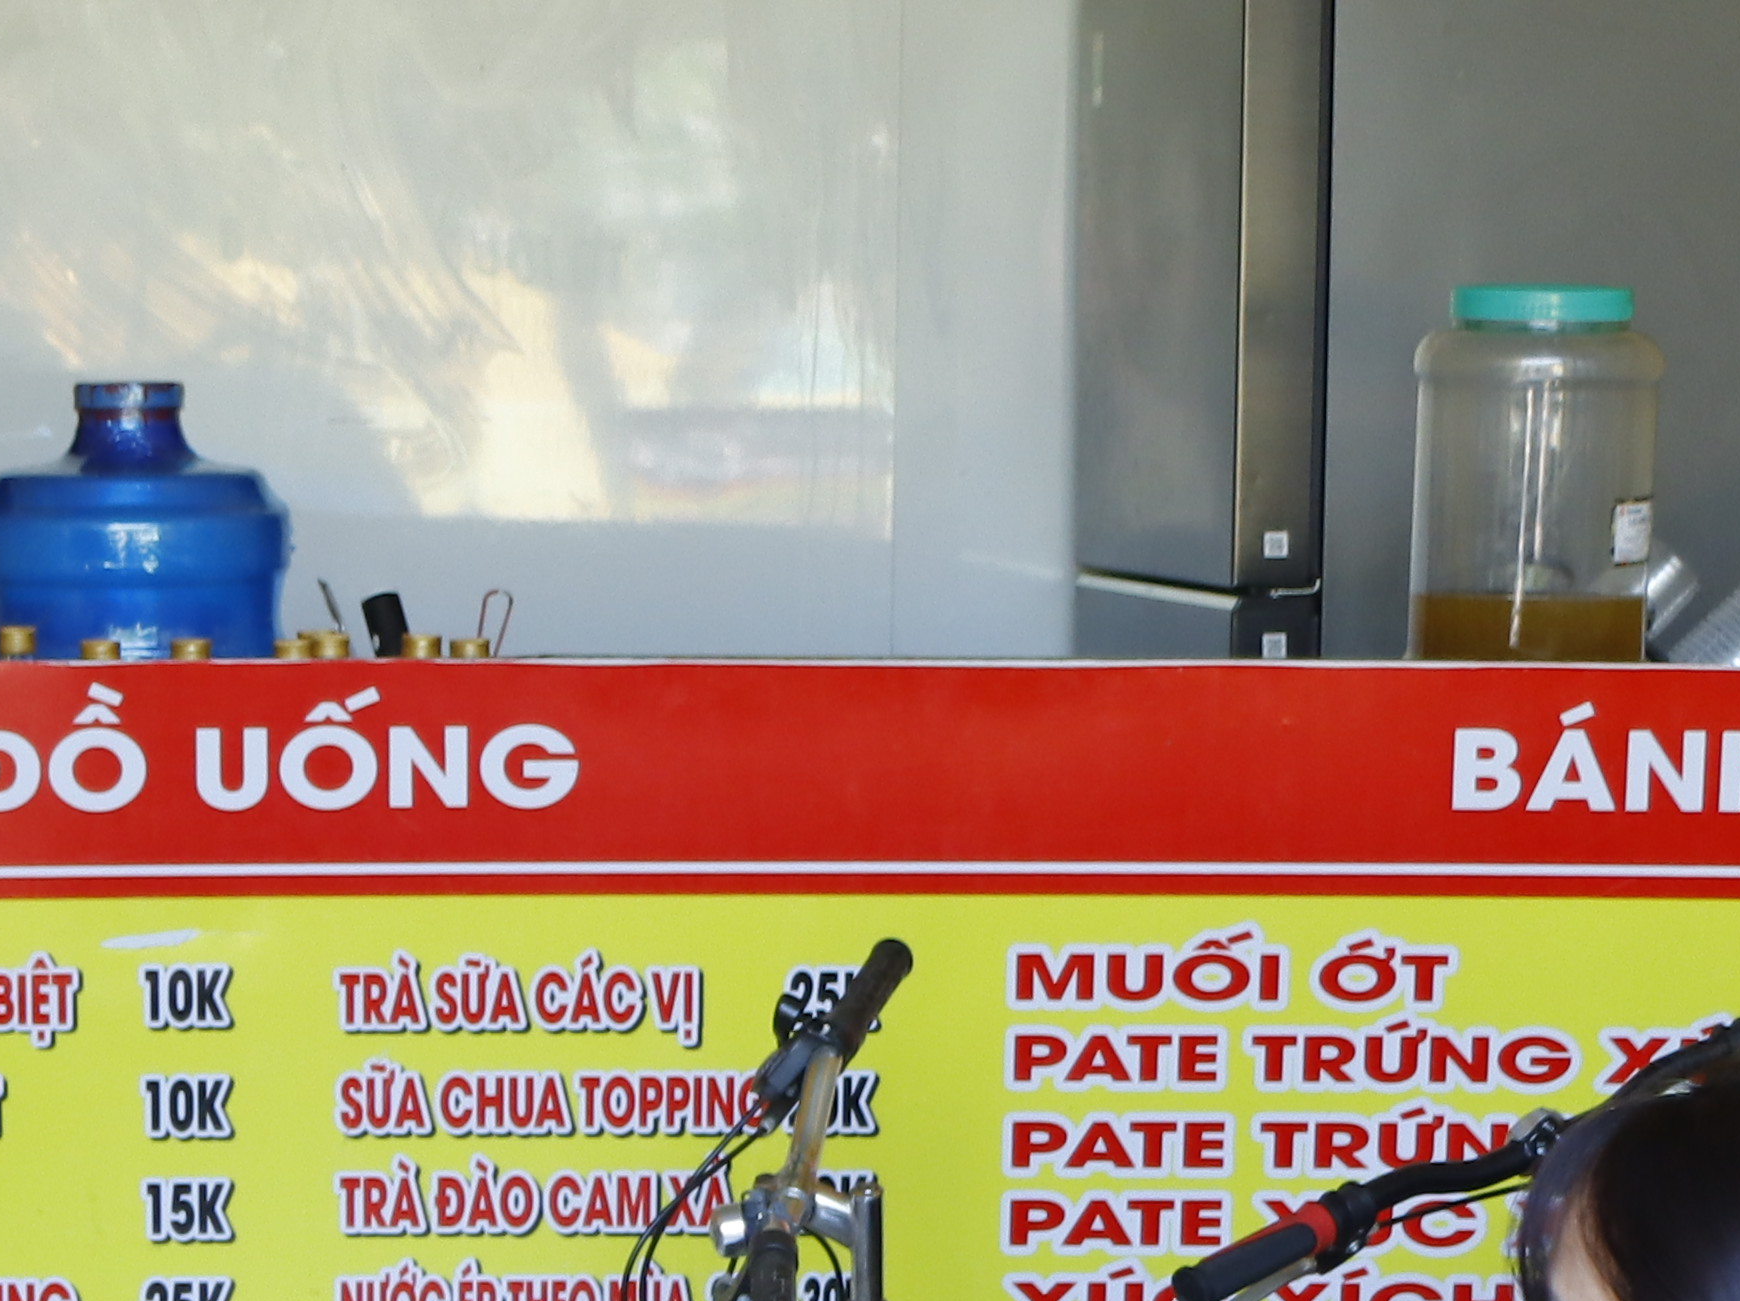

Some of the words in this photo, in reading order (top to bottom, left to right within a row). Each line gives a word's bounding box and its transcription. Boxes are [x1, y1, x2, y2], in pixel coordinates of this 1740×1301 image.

[196, 686, 579, 811] UỐNG
[144, 968, 231, 1028] 10K
[338, 955, 423, 1027] TRÀ
[433, 957, 523, 1027] SỮA
[534, 954, 639, 1027] CÁC
[650, 969, 696, 1041] VỊ
[1014, 929, 1283, 1004] MUỐI
[1317, 937, 1452, 1005] ỚT
[1012, 1032, 1221, 1085] PATE
[1250, 1018, 1574, 1087] TRỨNG
[144, 1078, 232, 1133] 10K
[339, 1062, 427, 1131] SỮA
[439, 1074, 567, 1131] CHUA
[578, 1073, 771, 1131] TOPPING
[1010, 1119, 1228, 1171] PATE
[1259, 1105, 1513, 1172] TRỨN
[144, 1182, 232, 1237] 15K
[338, 1160, 422, 1229] TRÀ
[433, 1159, 536, 1230] ĐÀO
[547, 1173, 654, 1230] CAM
[1006, 1197, 1223, 1250] PATE
